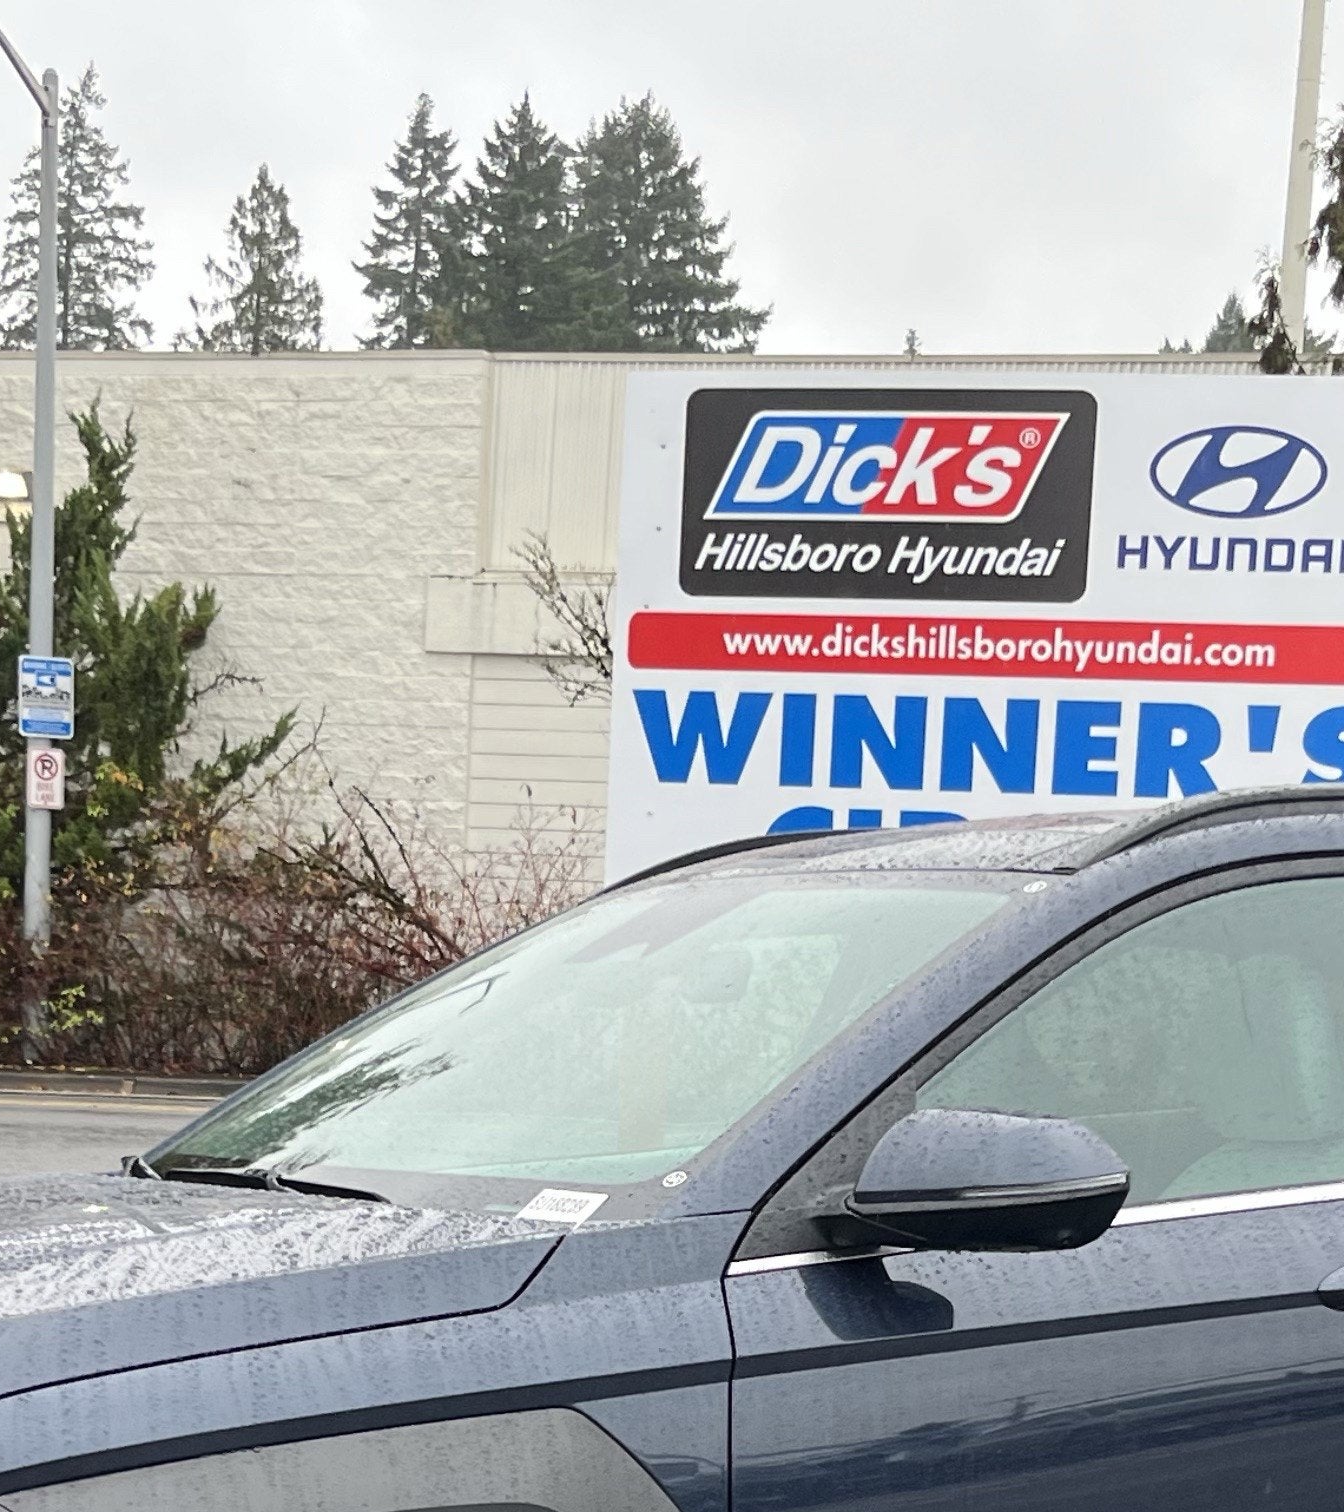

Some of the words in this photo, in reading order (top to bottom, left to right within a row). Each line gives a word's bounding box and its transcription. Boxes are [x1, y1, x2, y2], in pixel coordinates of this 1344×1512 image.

[733, 424, 1022, 508] Dick's
[694, 532, 883, 575] Hillsboro
[887, 536, 1066, 584] Hyundai
[722, 623, 1277, 669] www.dickshillsborohyundai.com
